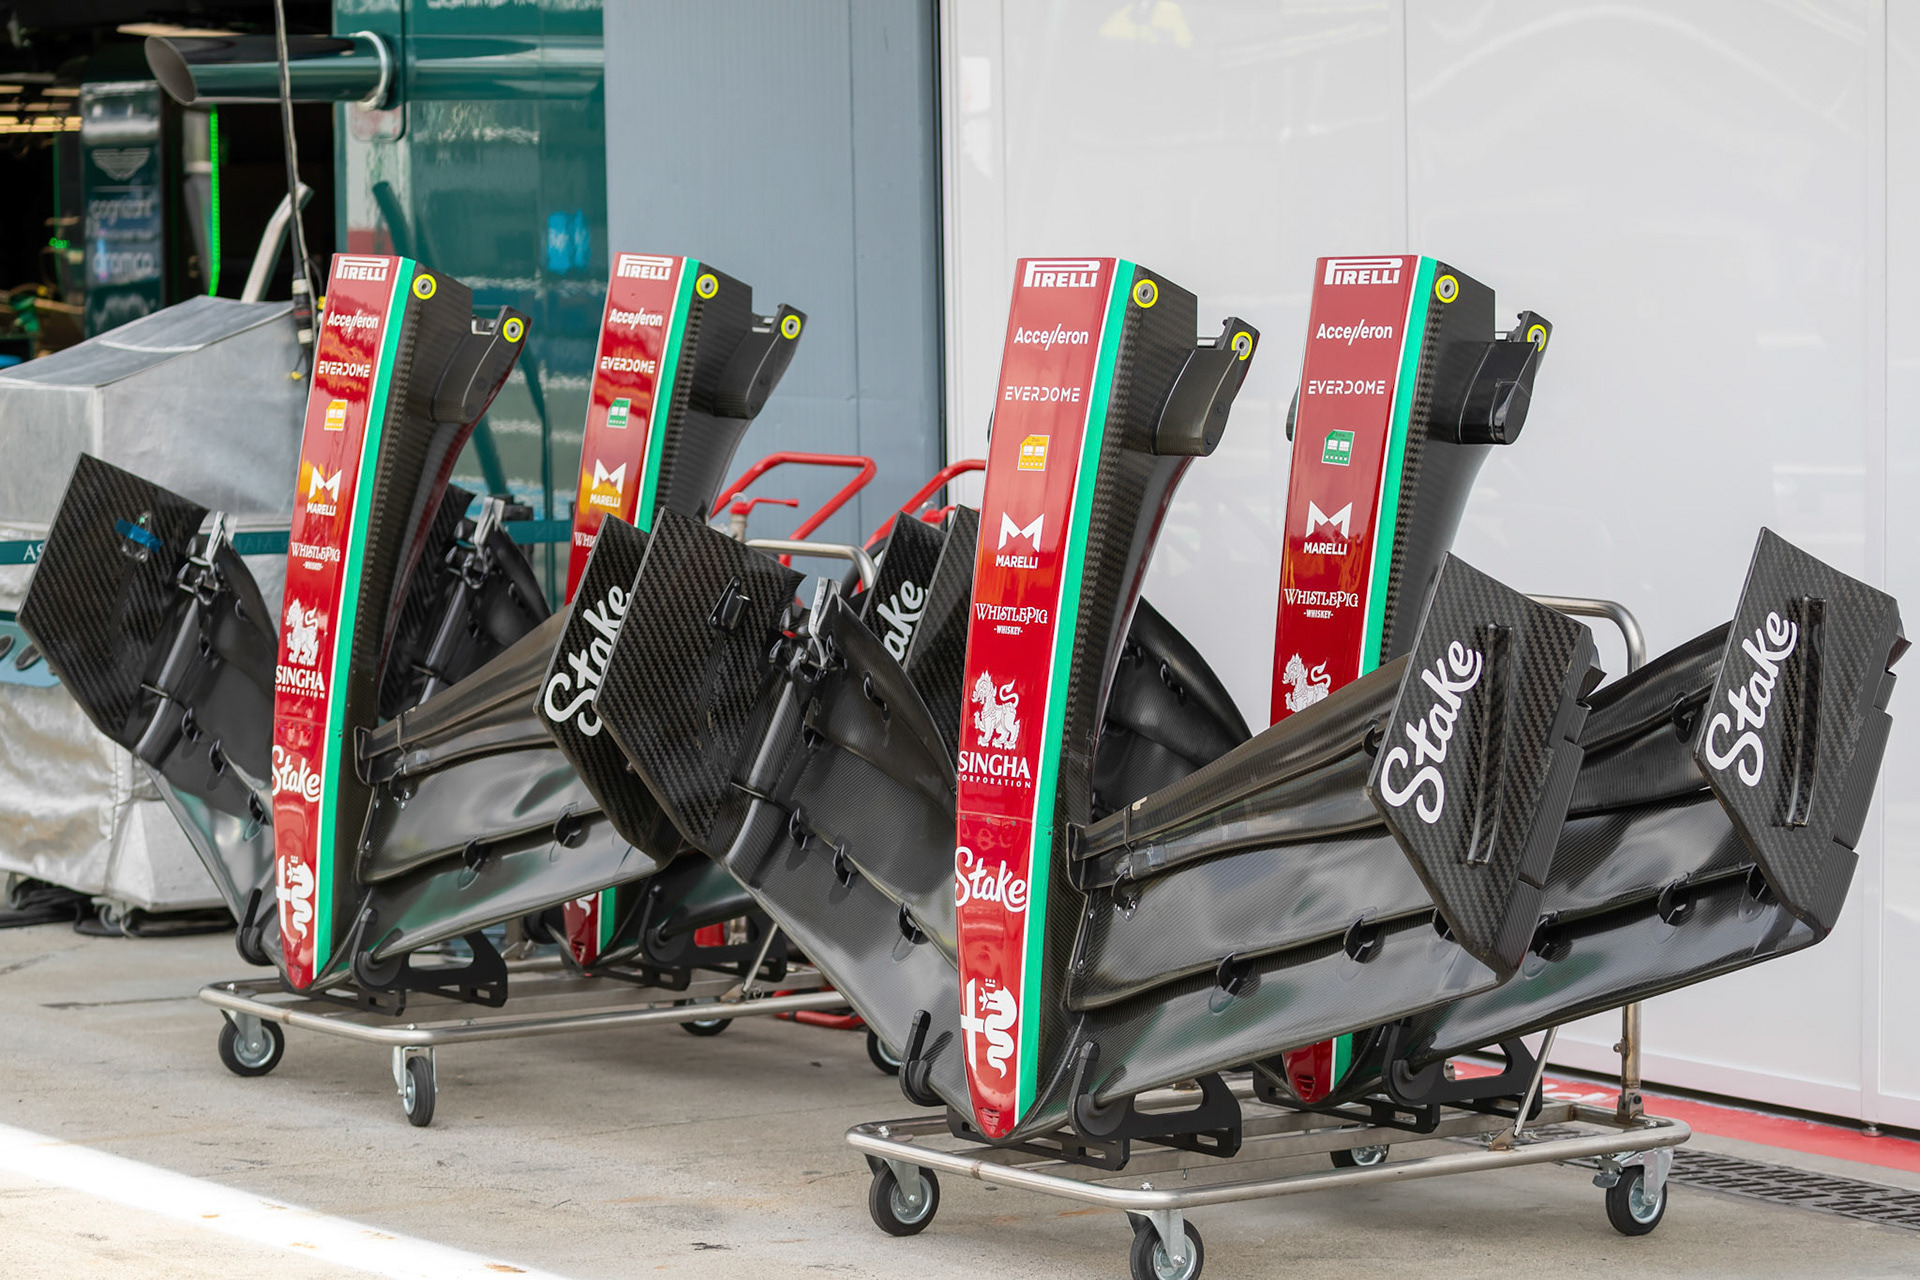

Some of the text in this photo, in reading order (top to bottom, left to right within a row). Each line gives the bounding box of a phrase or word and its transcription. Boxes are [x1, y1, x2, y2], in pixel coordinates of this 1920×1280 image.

[336, 256, 390, 281] PIRELLI
[617, 254, 673, 280] PIRELLI
[1023, 260, 1101, 288] PIRELLI
[1323, 258, 1403, 285] PIRELLI
[318, 361, 371, 378] EVERDOME
[601, 356, 656, 374] EVERDOME
[1004, 386, 1081, 402] EVERDOME
[1307, 380, 1386, 395] EVERDOME
[306, 502, 337, 516] MARELLI
[589, 493, 621, 508] MARELLI
[995, 554, 1039, 569] MARELLI
[1303, 542, 1348, 556] MARELLI
[544, 585, 631, 737] Stake
[275, 664, 326, 692] SINGHA
[1705, 611, 1798, 787] Stake
[1380, 640, 1483, 824] Stake
[272, 744, 320, 803] Stake
[958, 750, 1031, 779] SINGHA
[955, 846, 1027, 913] Stake
